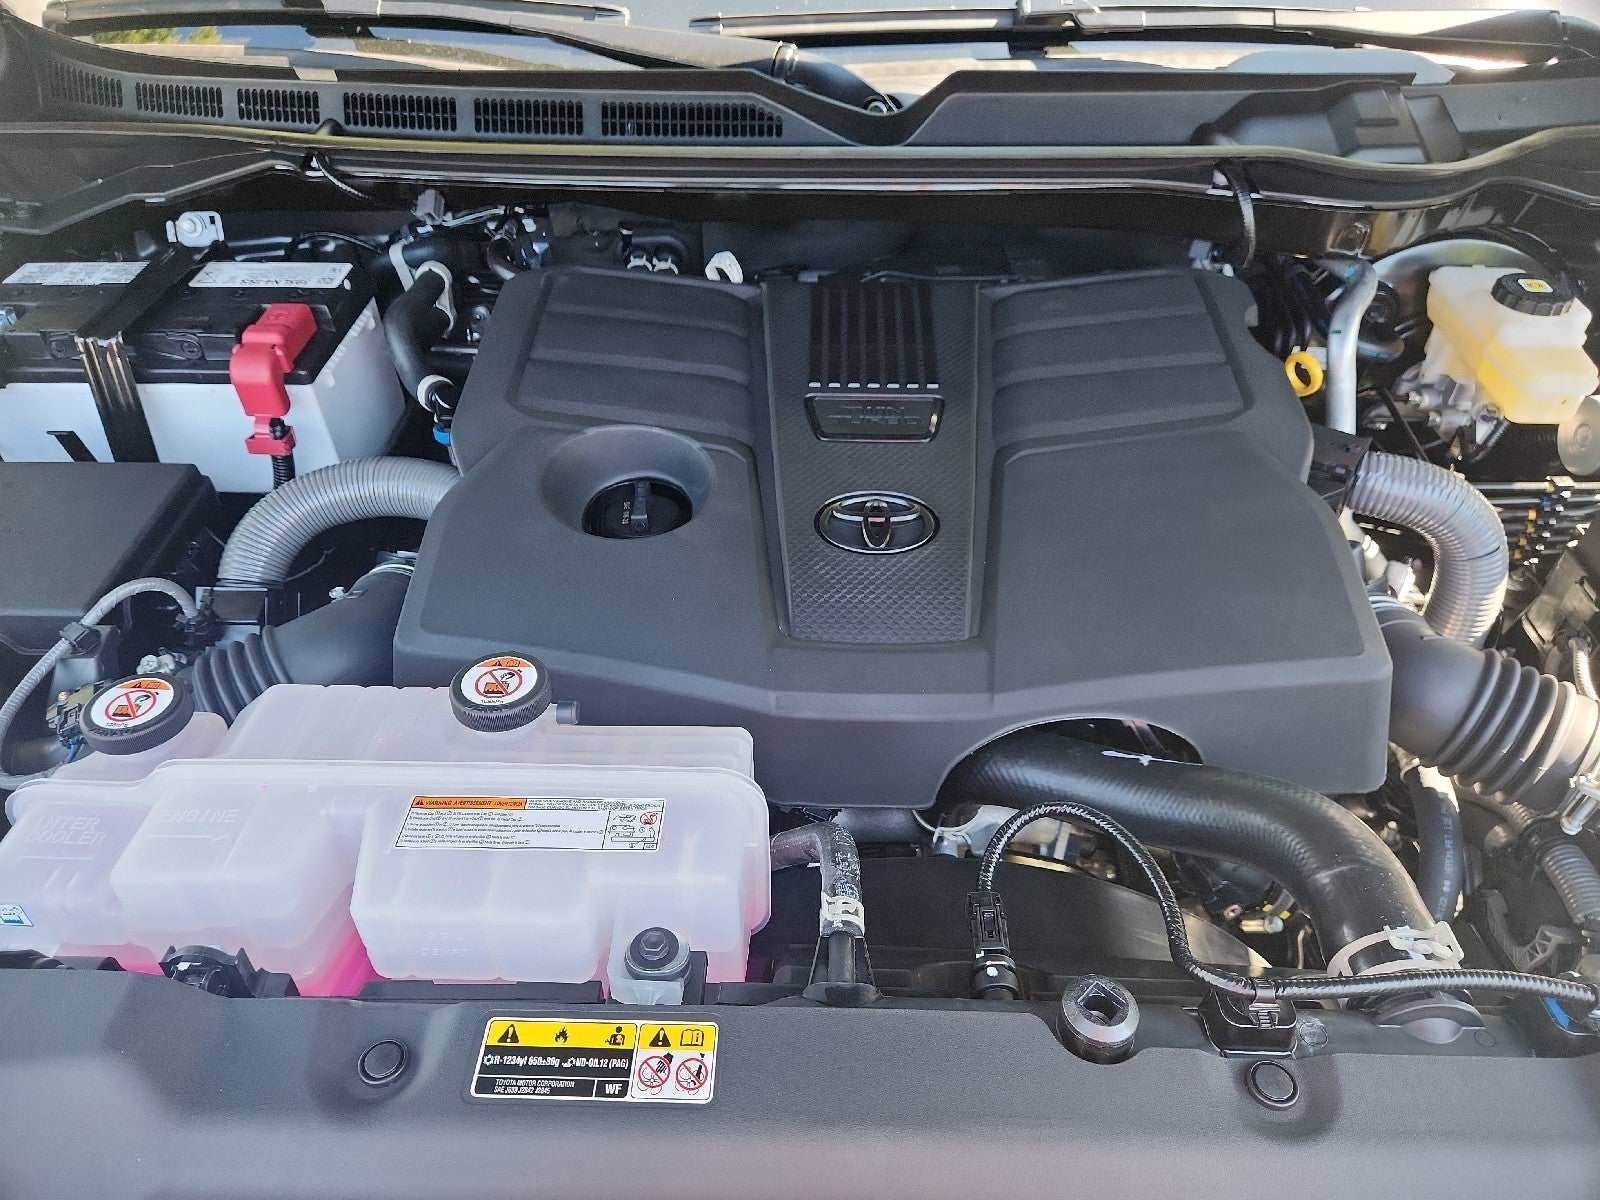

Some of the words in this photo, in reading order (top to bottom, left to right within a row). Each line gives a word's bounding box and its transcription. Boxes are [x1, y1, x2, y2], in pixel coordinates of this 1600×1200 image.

[160, 808, 241, 824] ENGINE
[26, 830, 108, 846] COOLER
[608, 1058, 629, 1070] (PAG)
[493, 1085, 505, 1093] SAE
[495, 1078, 516, 1086] TOYOTA
[517, 1079, 537, 1087] MOTOR
[537, 1080, 575, 1088] CORPORATION
[605, 1083, 623, 1095] WF
